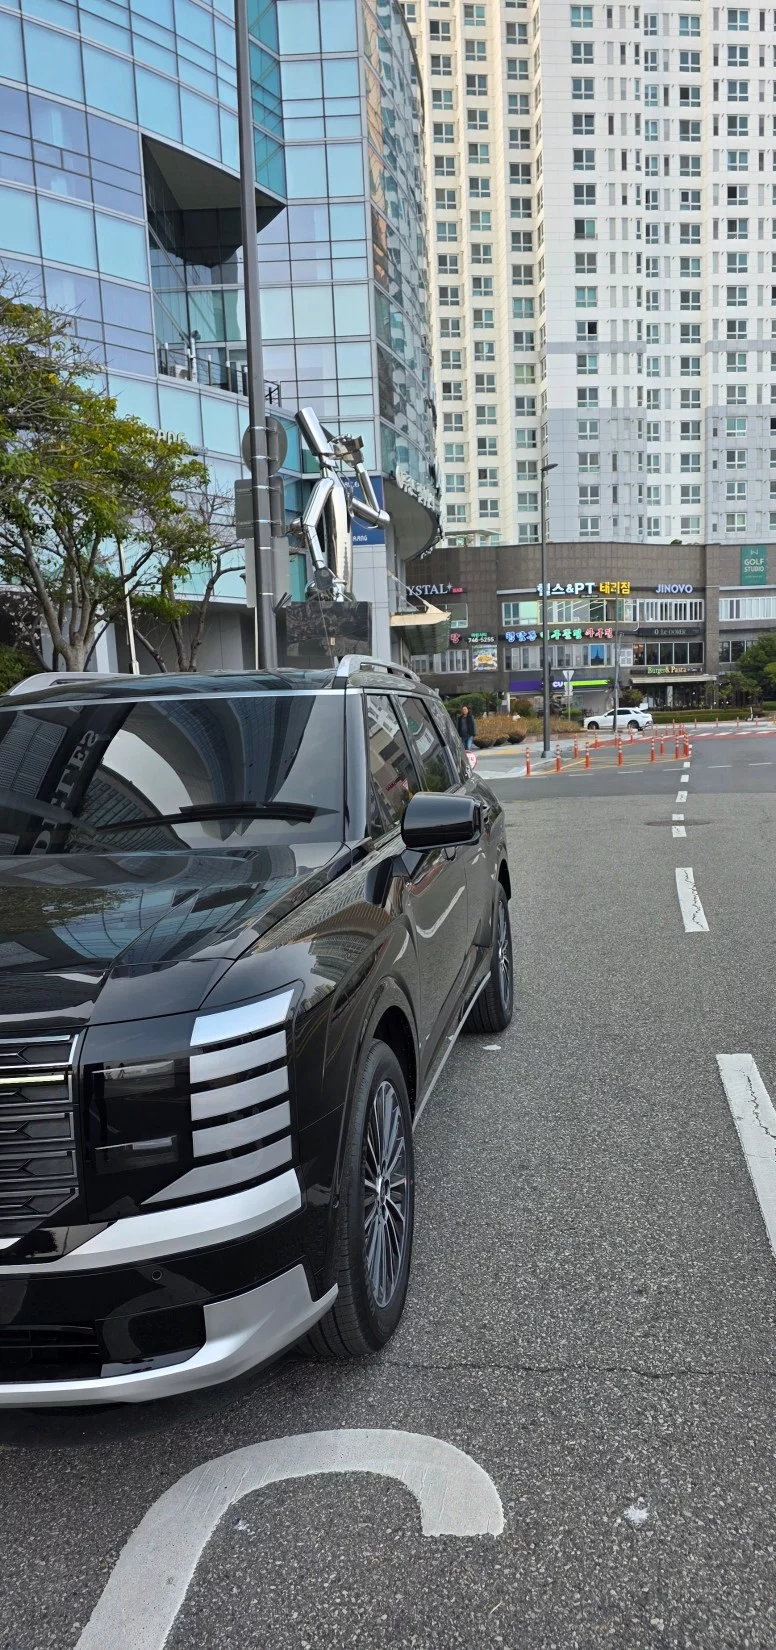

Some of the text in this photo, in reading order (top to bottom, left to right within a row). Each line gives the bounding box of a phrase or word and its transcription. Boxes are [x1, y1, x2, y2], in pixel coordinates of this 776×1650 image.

[744, 558, 765, 566] GOLF
[744, 565, 765, 573] STUDIO
[655, 583, 693, 594] JINOVO
